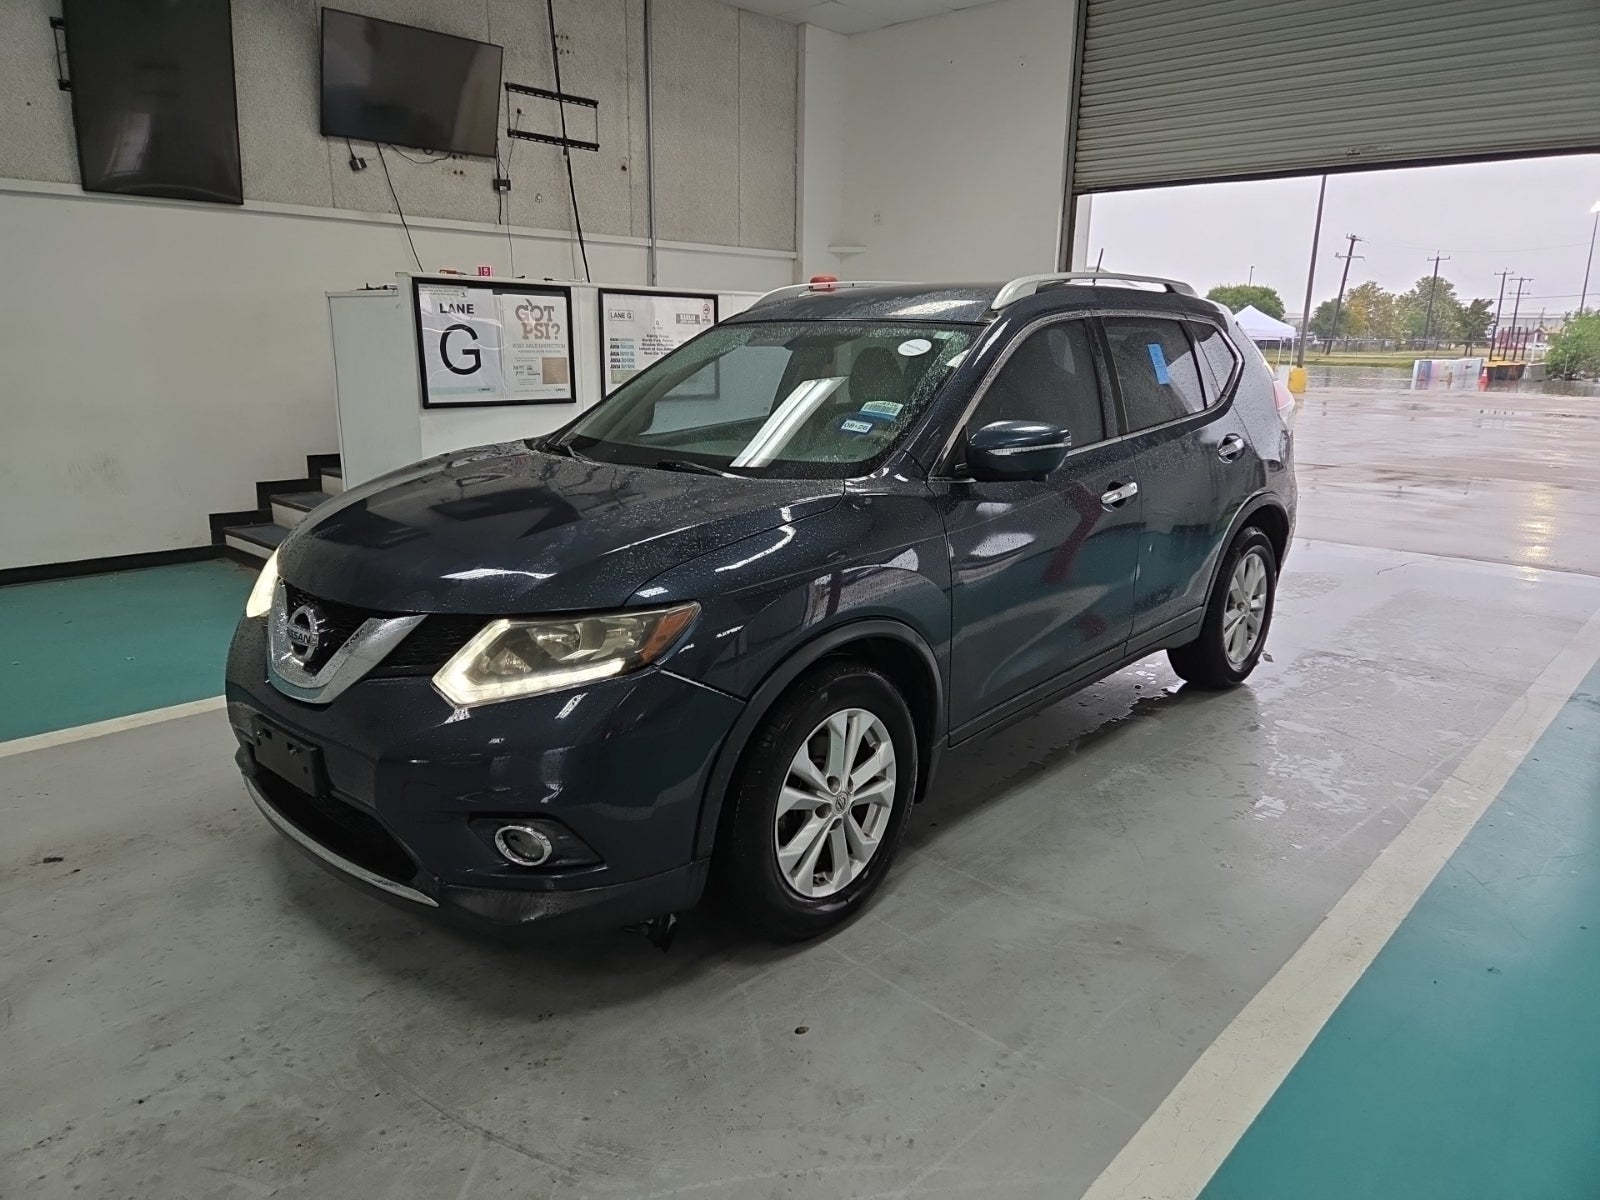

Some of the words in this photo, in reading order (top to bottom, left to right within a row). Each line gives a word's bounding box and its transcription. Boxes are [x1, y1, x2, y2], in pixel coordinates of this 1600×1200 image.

[439, 303, 474, 314] LANE
[515, 303, 554, 322] GOT
[521, 323, 560, 339] PSI?
[440, 324, 481, 375] G
